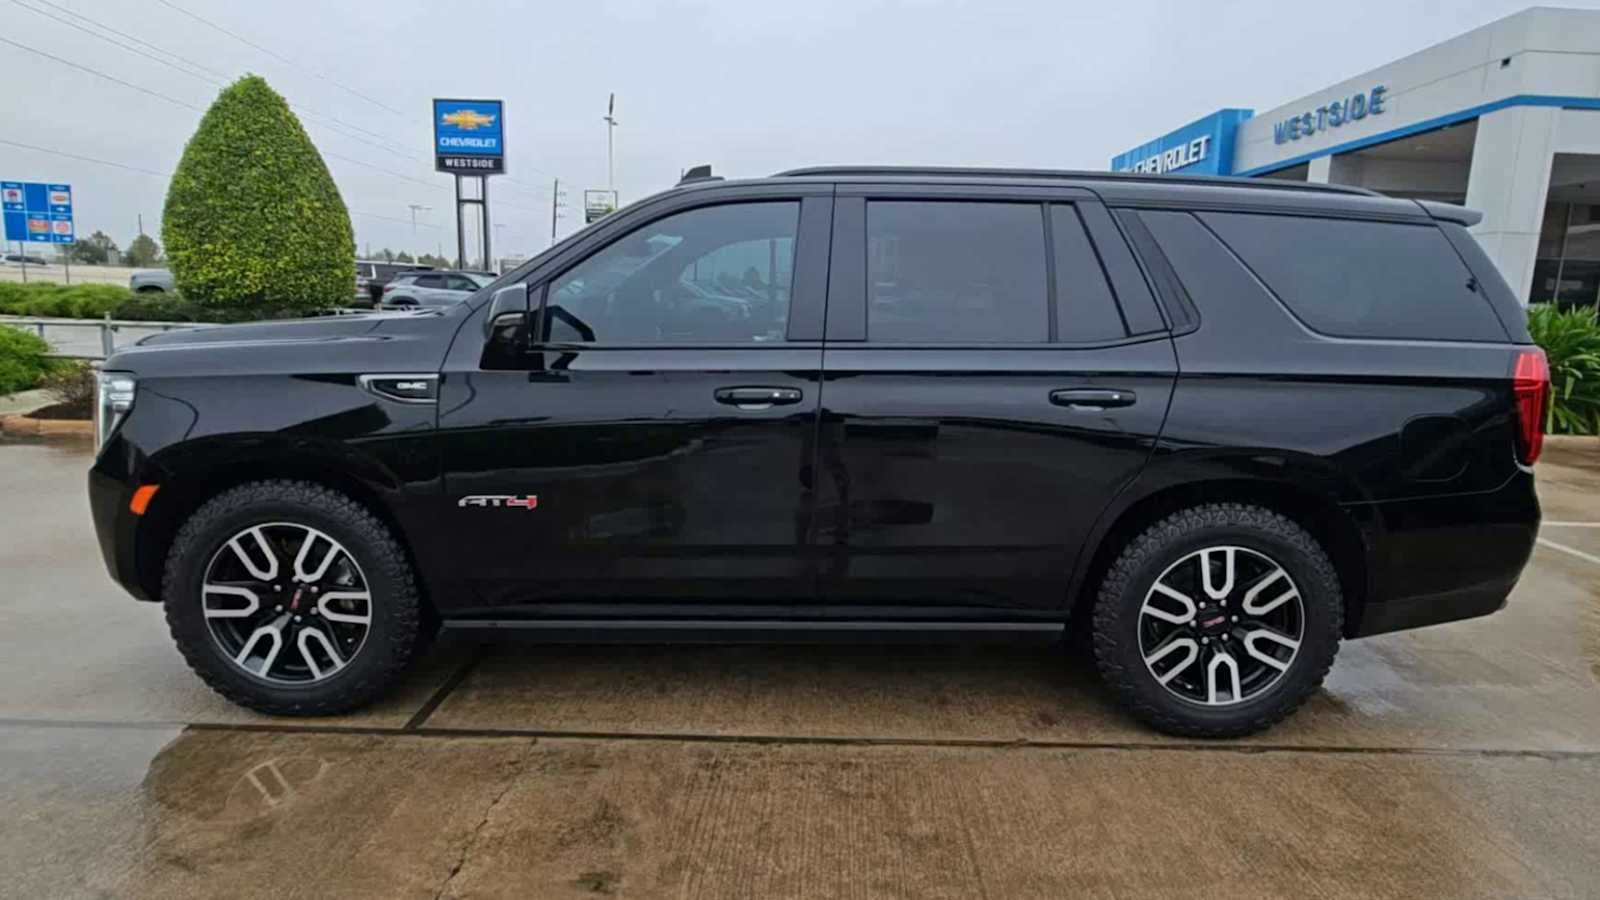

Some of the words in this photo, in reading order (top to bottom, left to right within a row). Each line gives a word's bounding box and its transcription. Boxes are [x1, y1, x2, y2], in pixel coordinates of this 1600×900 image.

[1274, 85, 1386, 145] WESTSIDE
[440, 137, 497, 148] CHEVROLET
[1134, 134, 1211, 174] CHEVROLET
[445, 158, 494, 168] WESTSIDE
[396, 381, 427, 390] GMC
[458, 495, 537, 509] AT4
